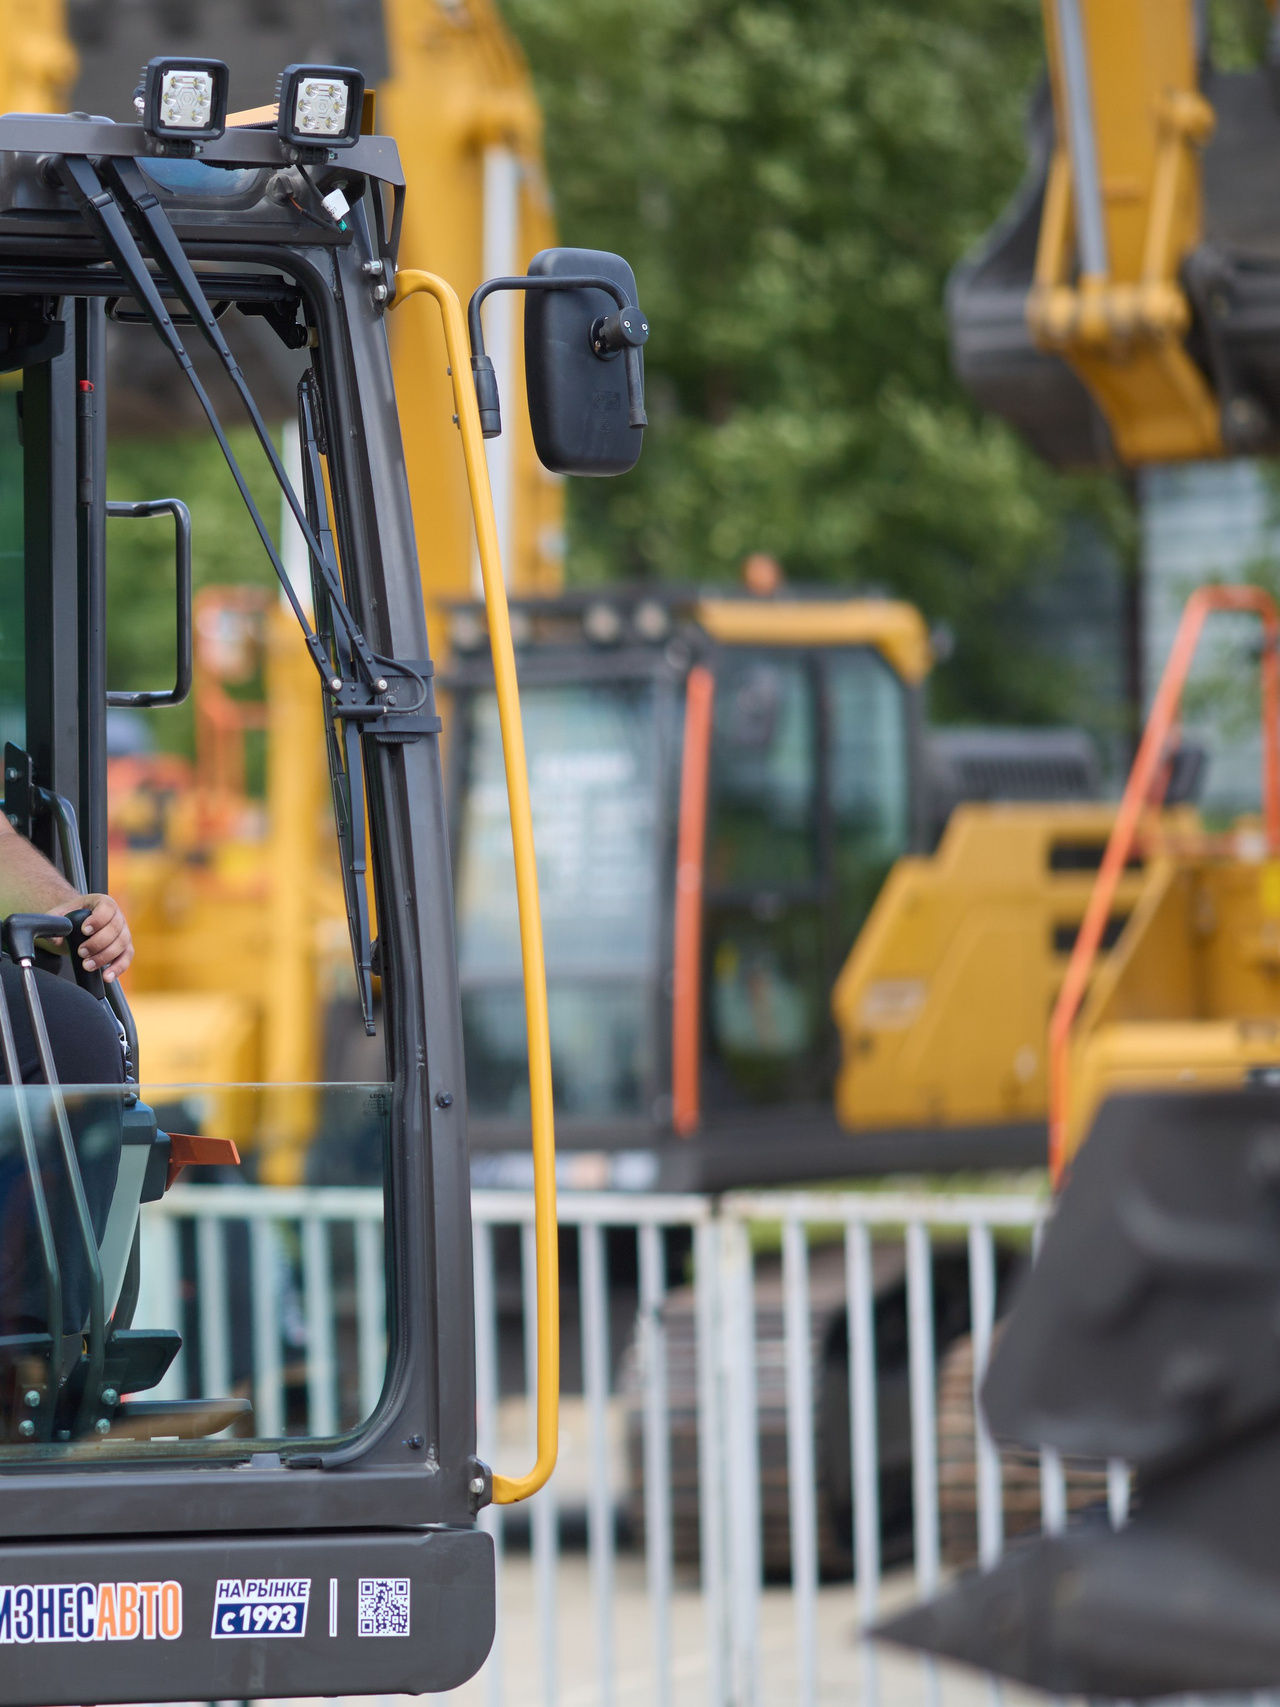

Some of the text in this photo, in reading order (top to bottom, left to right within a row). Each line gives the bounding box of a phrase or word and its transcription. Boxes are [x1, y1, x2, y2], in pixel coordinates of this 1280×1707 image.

[219, 1581, 308, 1597] НА РЫНКЕ
[239, 1604, 297, 1631] 1993
